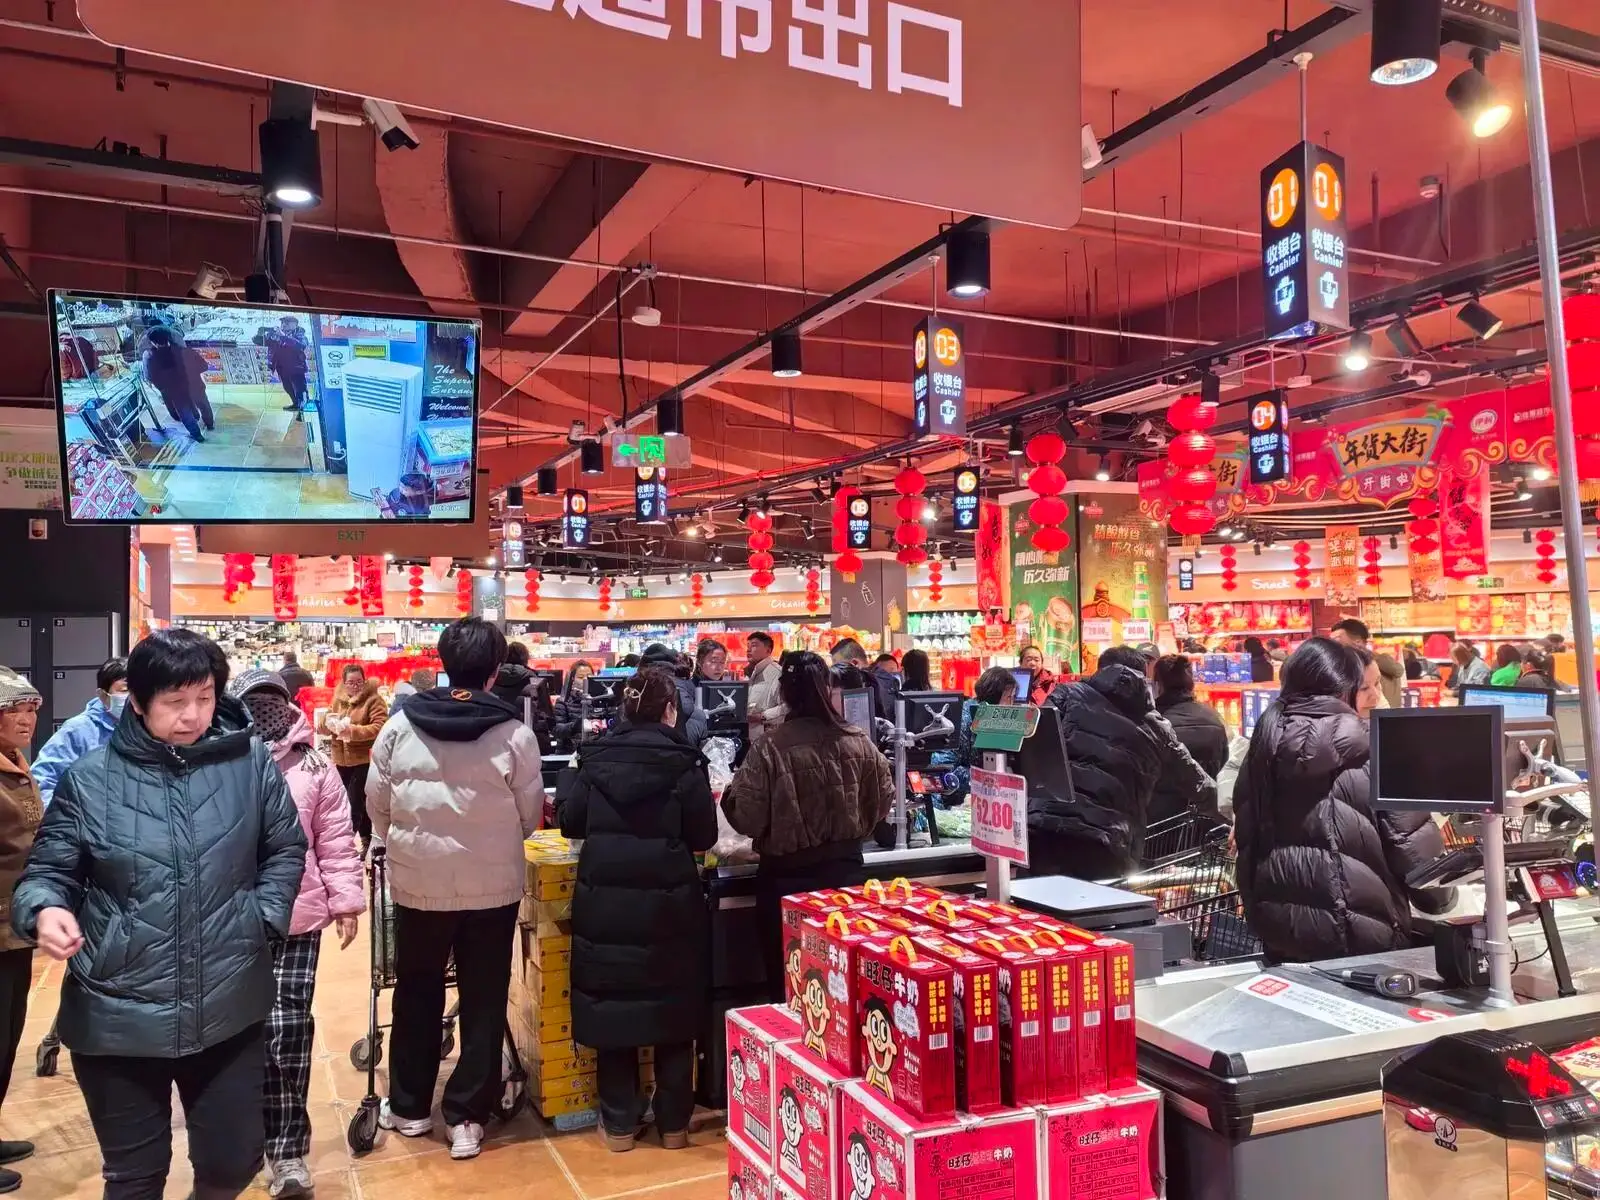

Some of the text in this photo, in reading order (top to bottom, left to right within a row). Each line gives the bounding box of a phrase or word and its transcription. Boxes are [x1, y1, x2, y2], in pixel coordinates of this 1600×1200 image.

[1269, 175, 1297, 222] 01
[1315, 171, 1341, 212] 01
[1267, 231, 1301, 264] 收银台
[1312, 228, 1344, 256] 收银台
[1269, 254, 1300, 277] Cashier
[1314, 249, 1342, 269] Cashier
[935, 333, 960, 361] 03
[433, 364, 455, 375] The
[934, 372, 962, 389] 收银台
[934, 385, 961, 398] Cashier
[1251, 406, 1276, 426] 04
[1250, 433, 1279, 448] 收银台
[1341, 426, 1429, 467] 年货大街
[954, 496, 978, 505] 收银台
[849, 519, 870, 527] 收银台
[337, 529, 367, 541] EXIT
[1022, 566, 1070, 585] 历久弥新
[1251, 577, 1292, 592] Snack
[864, 958, 920, 1008] 旺仔牛奶
